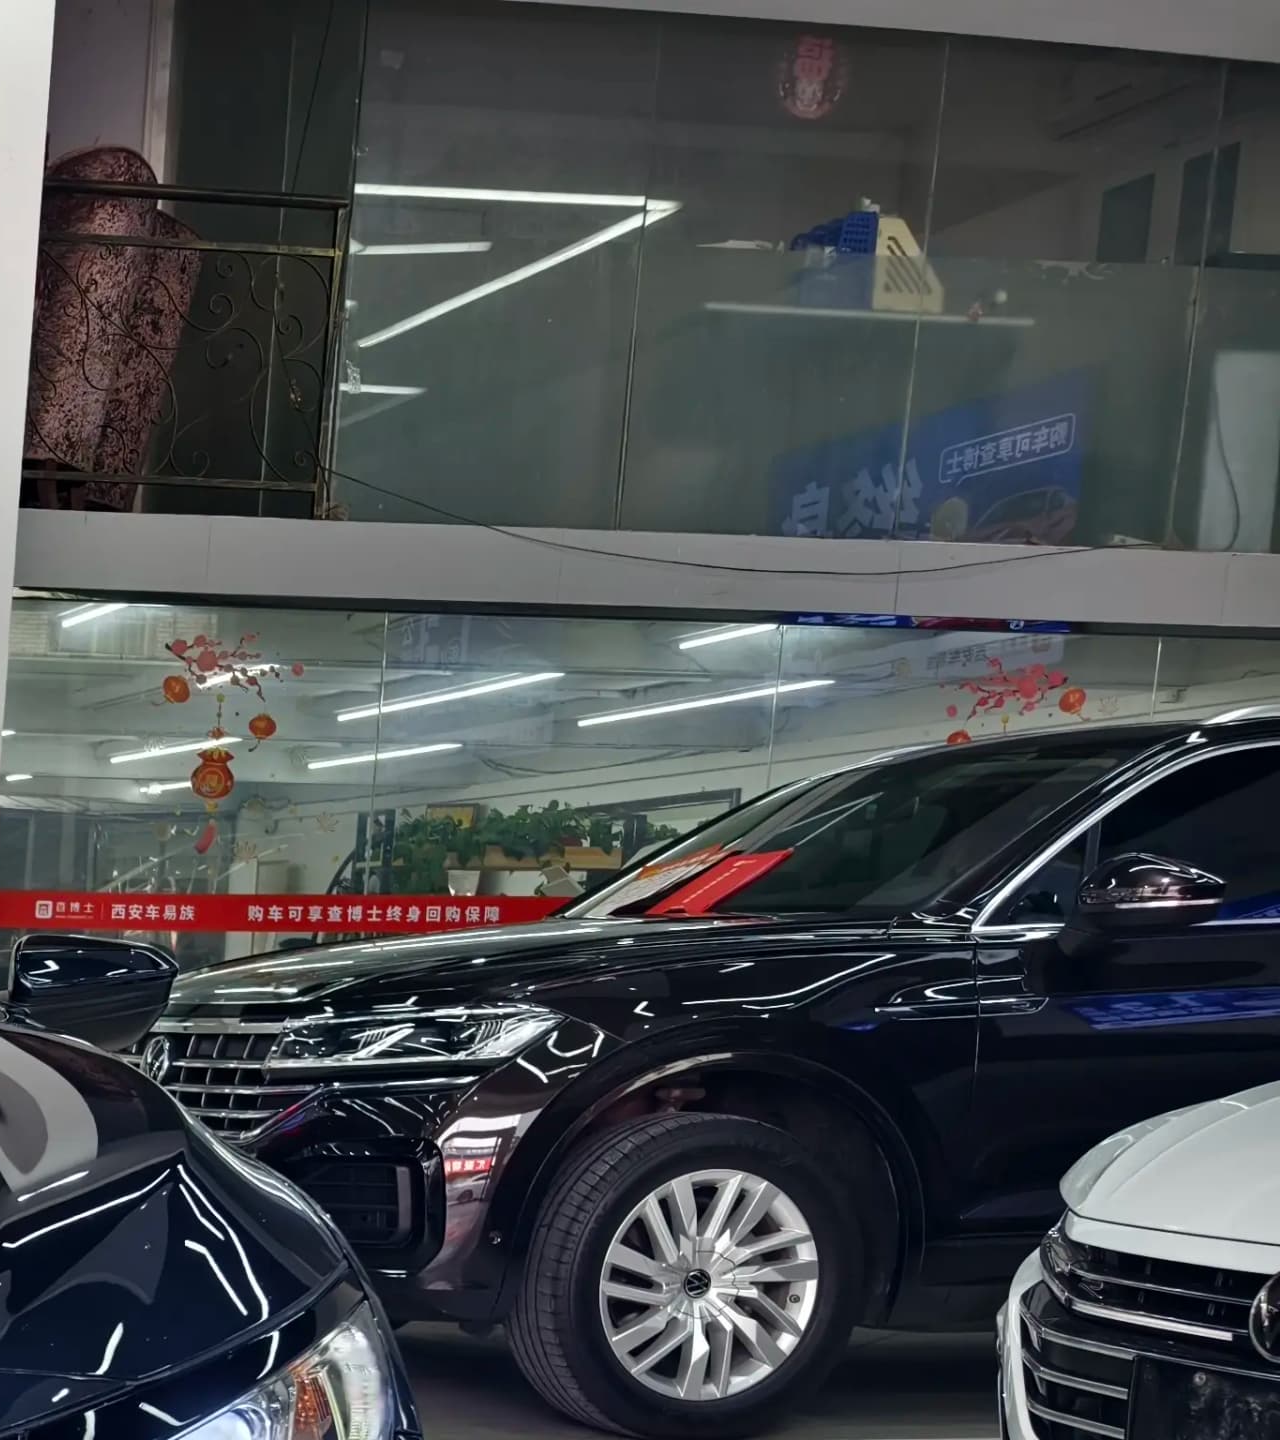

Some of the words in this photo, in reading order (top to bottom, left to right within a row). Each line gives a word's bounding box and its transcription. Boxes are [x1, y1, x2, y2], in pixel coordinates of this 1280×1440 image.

[111, 904, 196, 921] 西安车易族
[247, 905, 501, 923] 购车可享查博士终身回购保障
